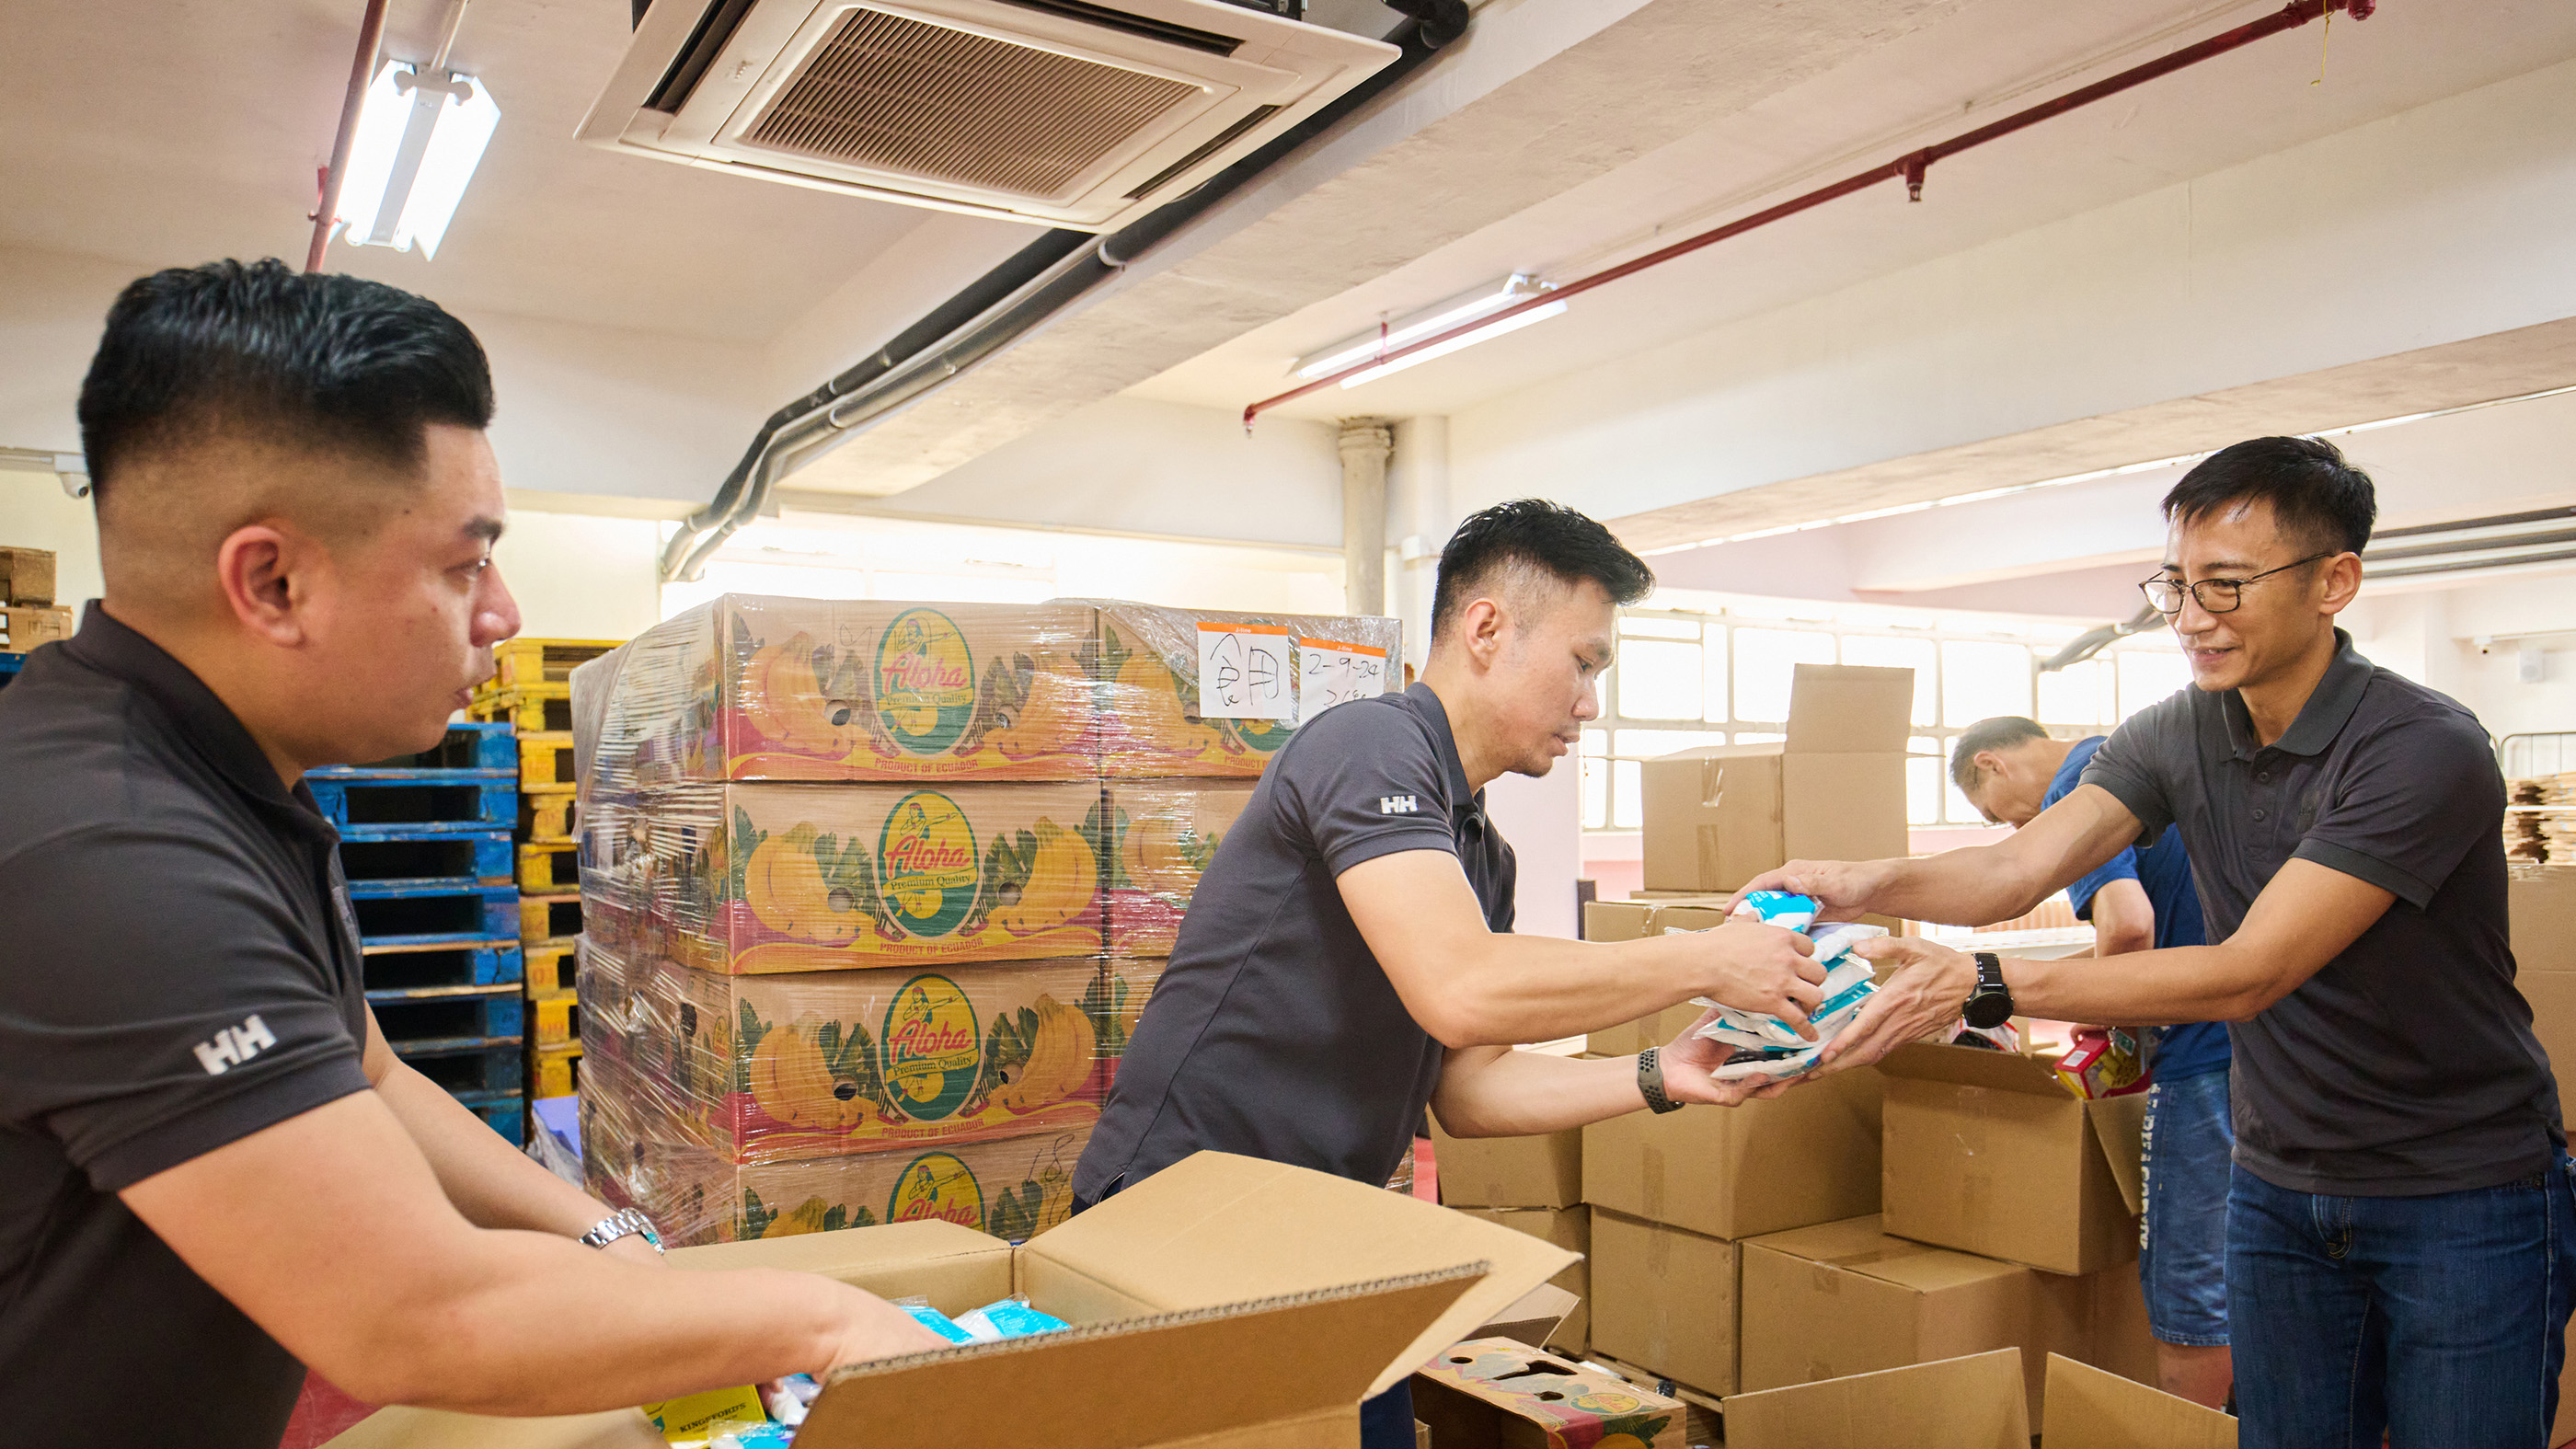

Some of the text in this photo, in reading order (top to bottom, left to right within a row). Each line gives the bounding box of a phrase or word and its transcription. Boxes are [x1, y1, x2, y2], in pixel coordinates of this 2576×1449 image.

[882, 653, 967, 694] Aloha
[886, 694, 967, 705] Premium Quality
[875, 758, 978, 773] PRODUCT OF ECUADOR
[1225, 755, 1260, 768] PRODUCT
[1380, 796, 1418, 813] HH
[885, 835, 971, 878] Aloha
[891, 875, 971, 890] Premium Quality
[880, 937, 983, 954] PRODUCT OF ECUADOR
[193, 1014, 278, 1075] HH
[890, 1020, 972, 1063] Aloha
[893, 1056, 972, 1075] Premium Quality
[881, 1119, 984, 1138] PRODUCT OF ECUADOR
[893, 1198, 977, 1225] Aloha
